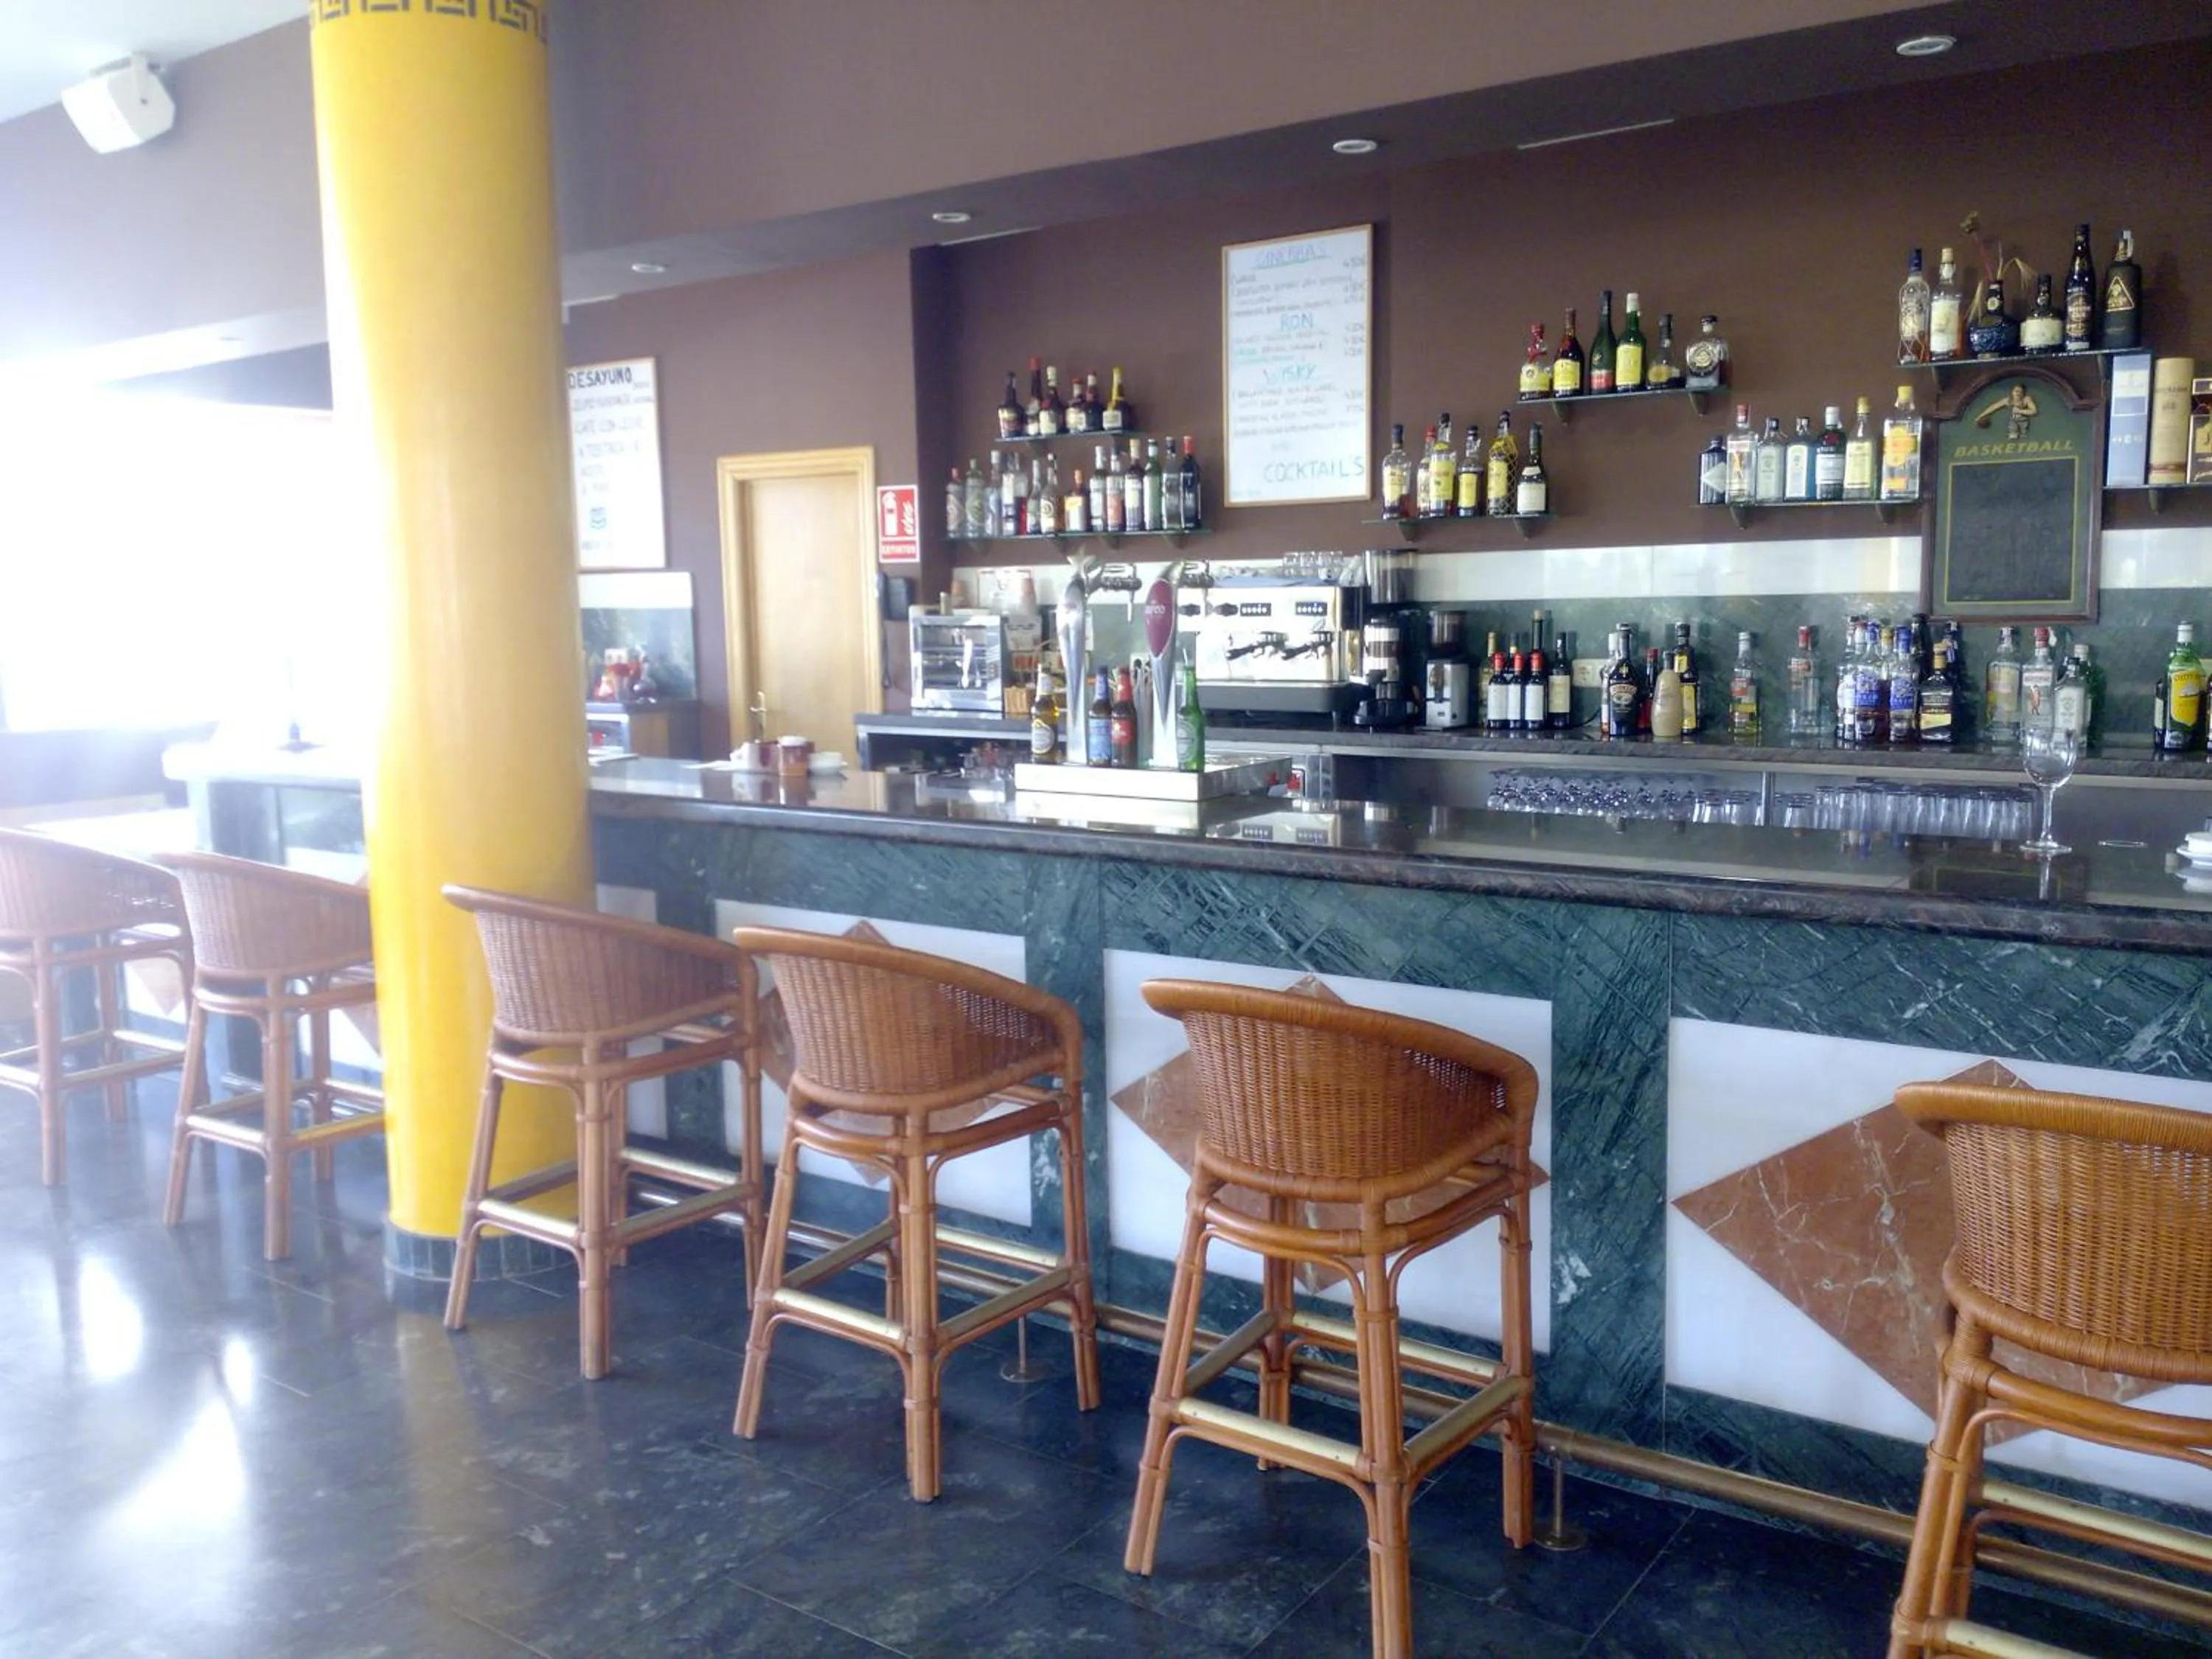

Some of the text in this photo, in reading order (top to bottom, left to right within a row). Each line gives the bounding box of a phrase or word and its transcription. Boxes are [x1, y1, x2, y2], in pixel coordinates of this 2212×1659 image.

[1280, 313, 1314, 331] RON
[567, 366, 632, 389] DESAYUNO
[1955, 440, 2073, 458] BASKETBALL
